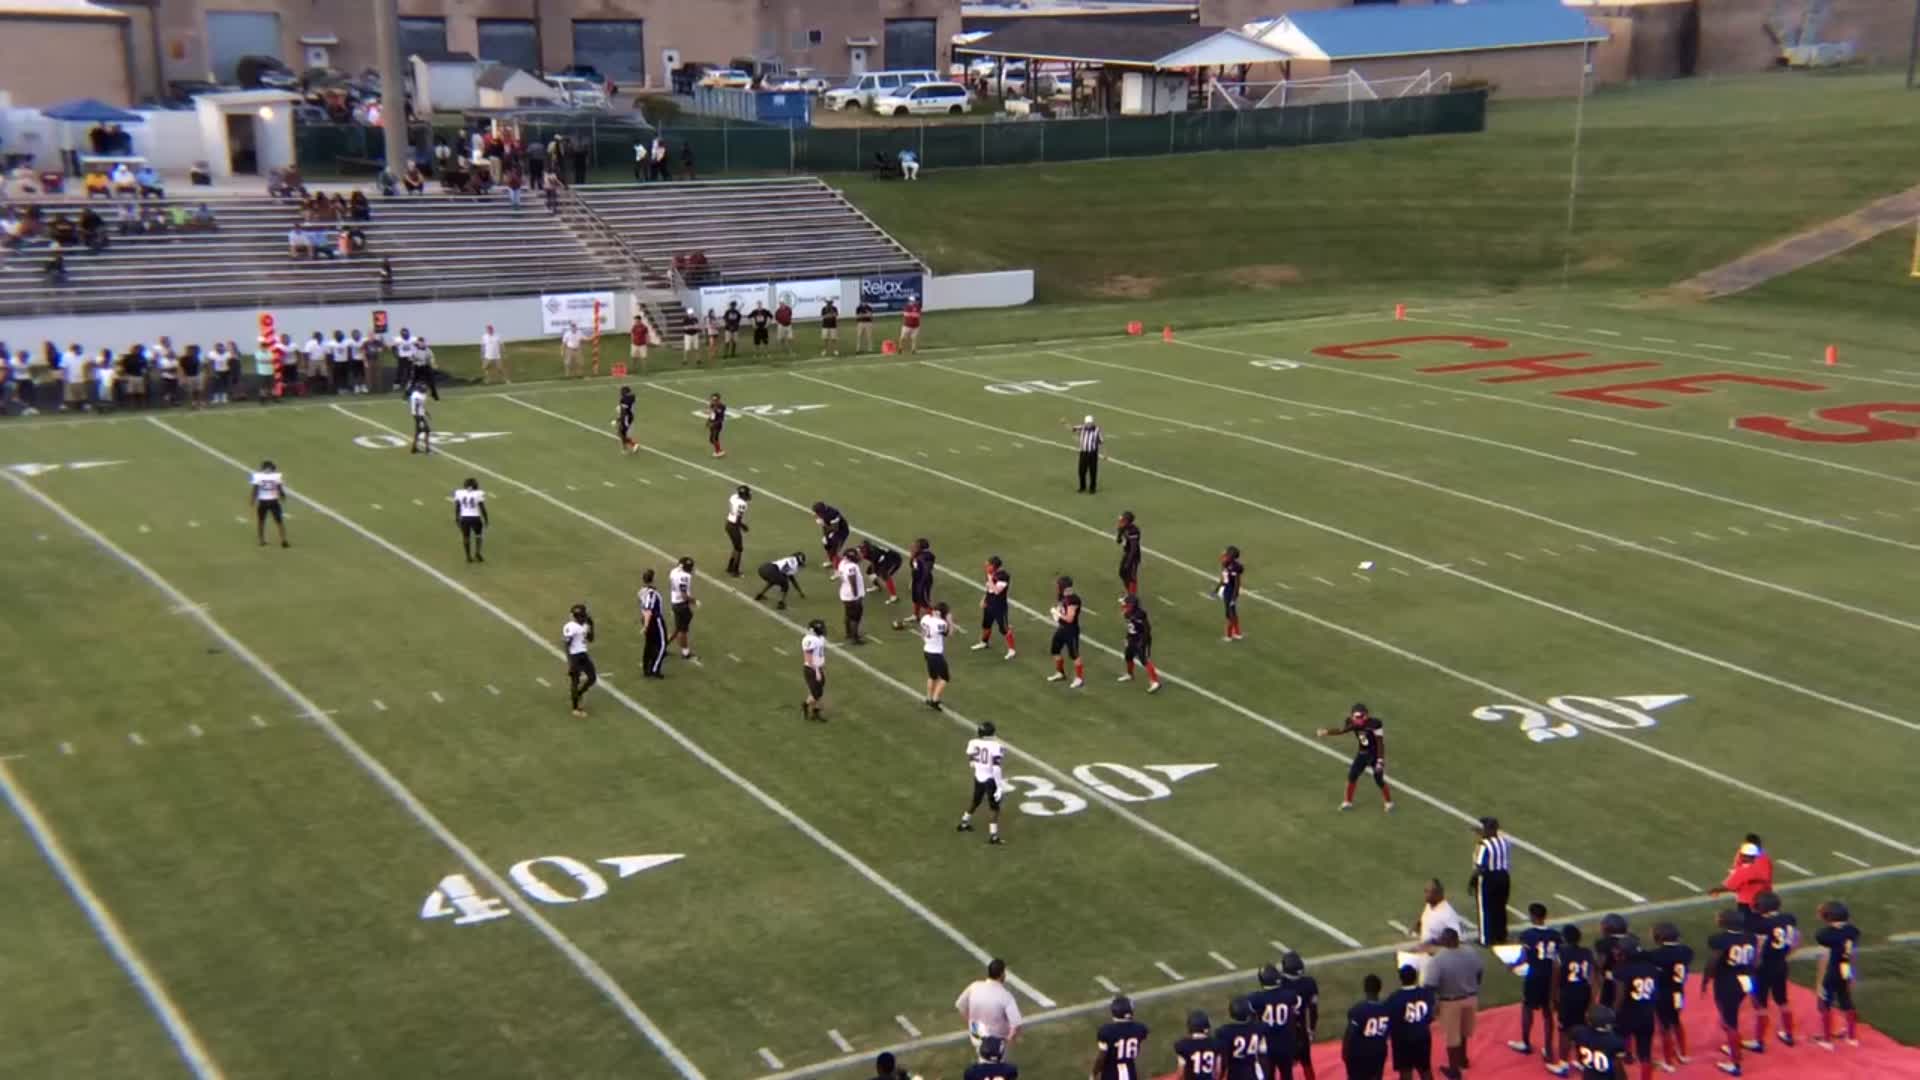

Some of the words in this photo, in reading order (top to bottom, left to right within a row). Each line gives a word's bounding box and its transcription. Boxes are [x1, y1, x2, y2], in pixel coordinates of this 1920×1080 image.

[1472, 695, 1656, 743] 20
[971, 746, 989, 765] 20
[1000, 762, 1172, 816] 30
[420, 855, 608, 925] 40
[1630, 977, 1654, 1000] 39
[1262, 1003, 1288, 1026] 40
[1115, 1038, 1138, 1059] 16
[1233, 1034, 1259, 1058] 24
[1191, 1051, 1214, 1074] 13
[1579, 1047, 1608, 1072] 20
